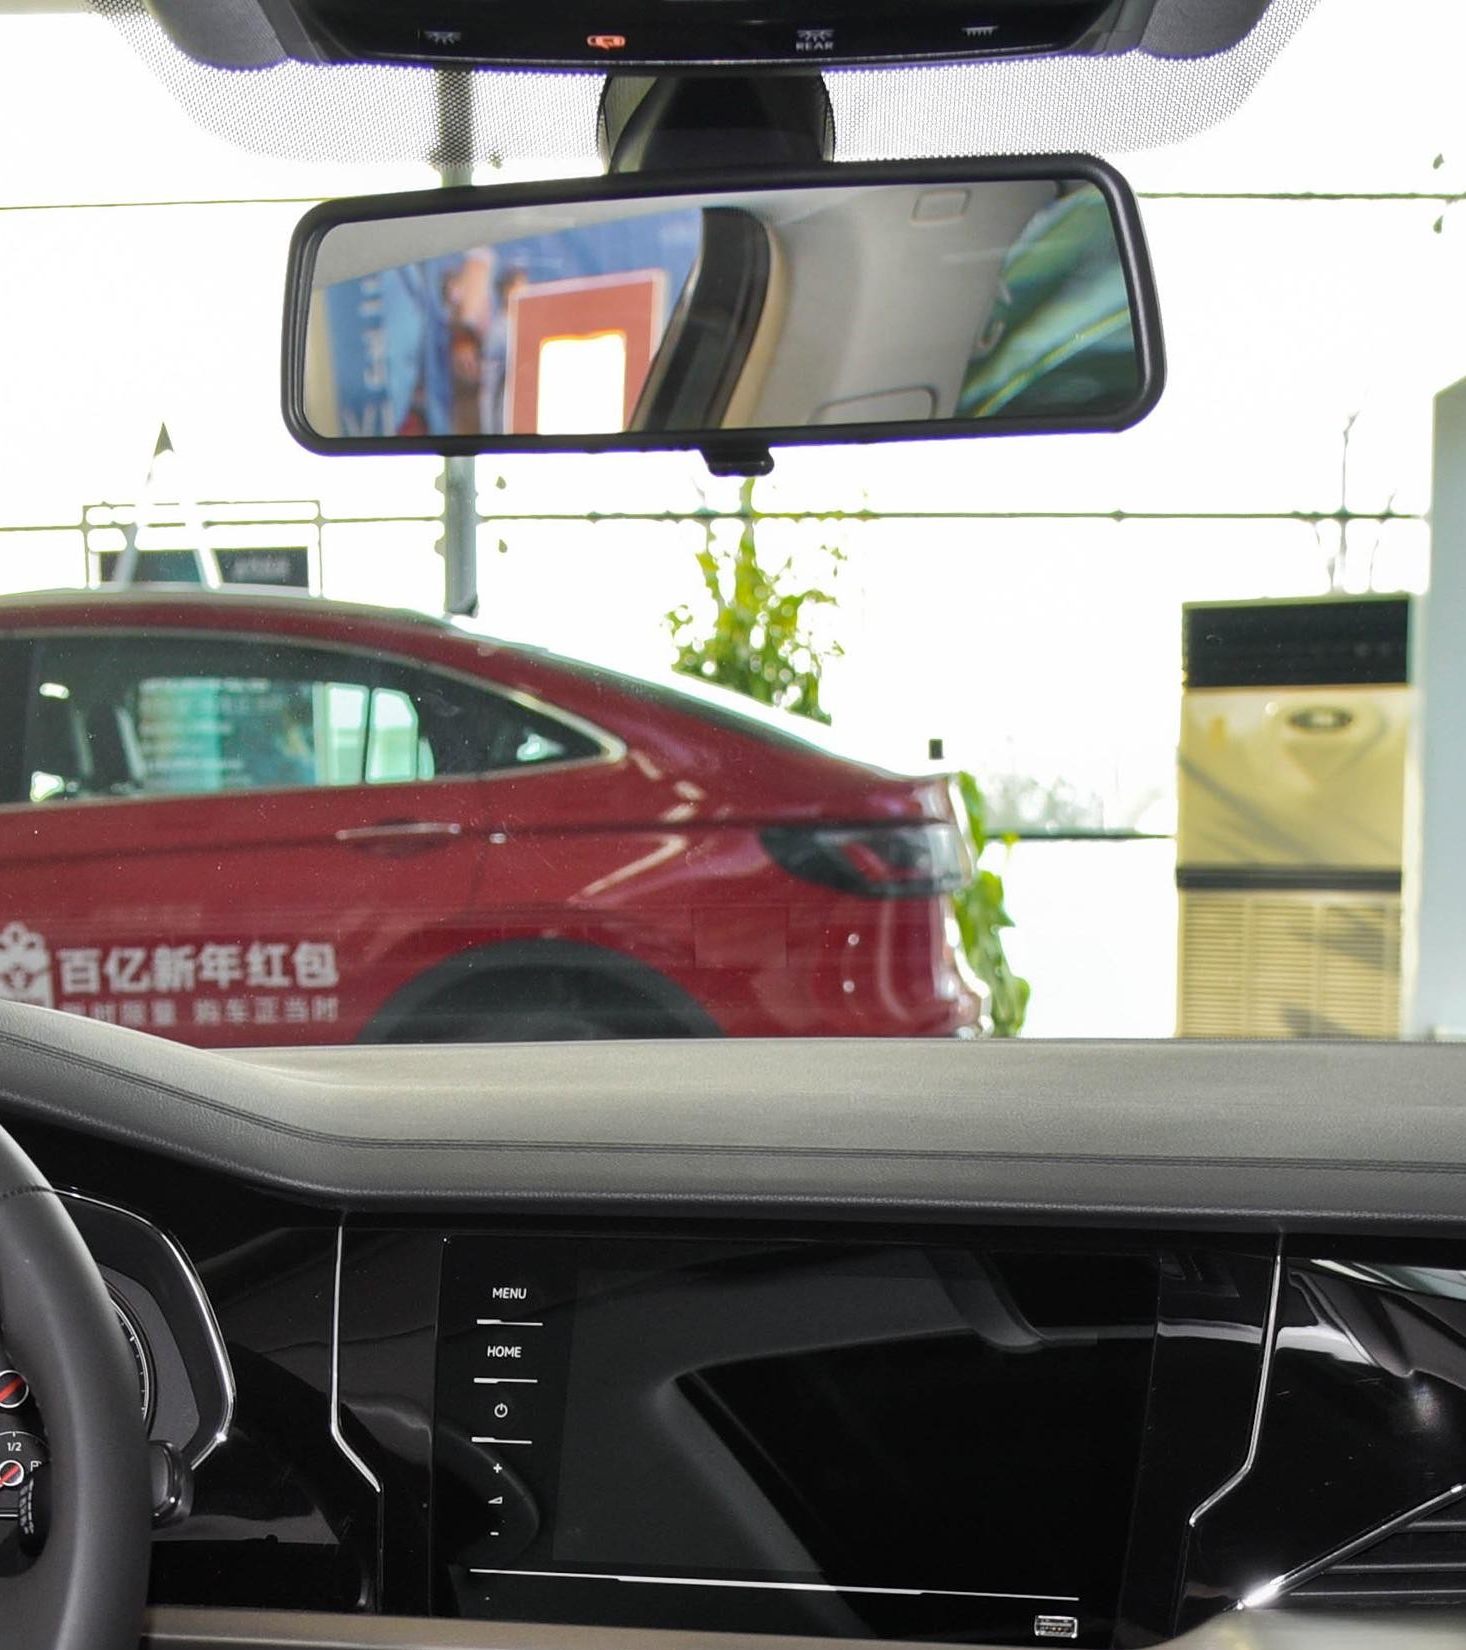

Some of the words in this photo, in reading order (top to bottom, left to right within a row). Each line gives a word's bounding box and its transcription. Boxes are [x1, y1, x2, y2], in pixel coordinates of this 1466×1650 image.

[795, 41, 834, 51] REAR
[56, 941, 339, 994] 百亿新年红包
[492, 1286, 527, 1300] MENU
[486, 1345, 522, 1359] HOME
[6, 1441, 22, 1452] 1/2
